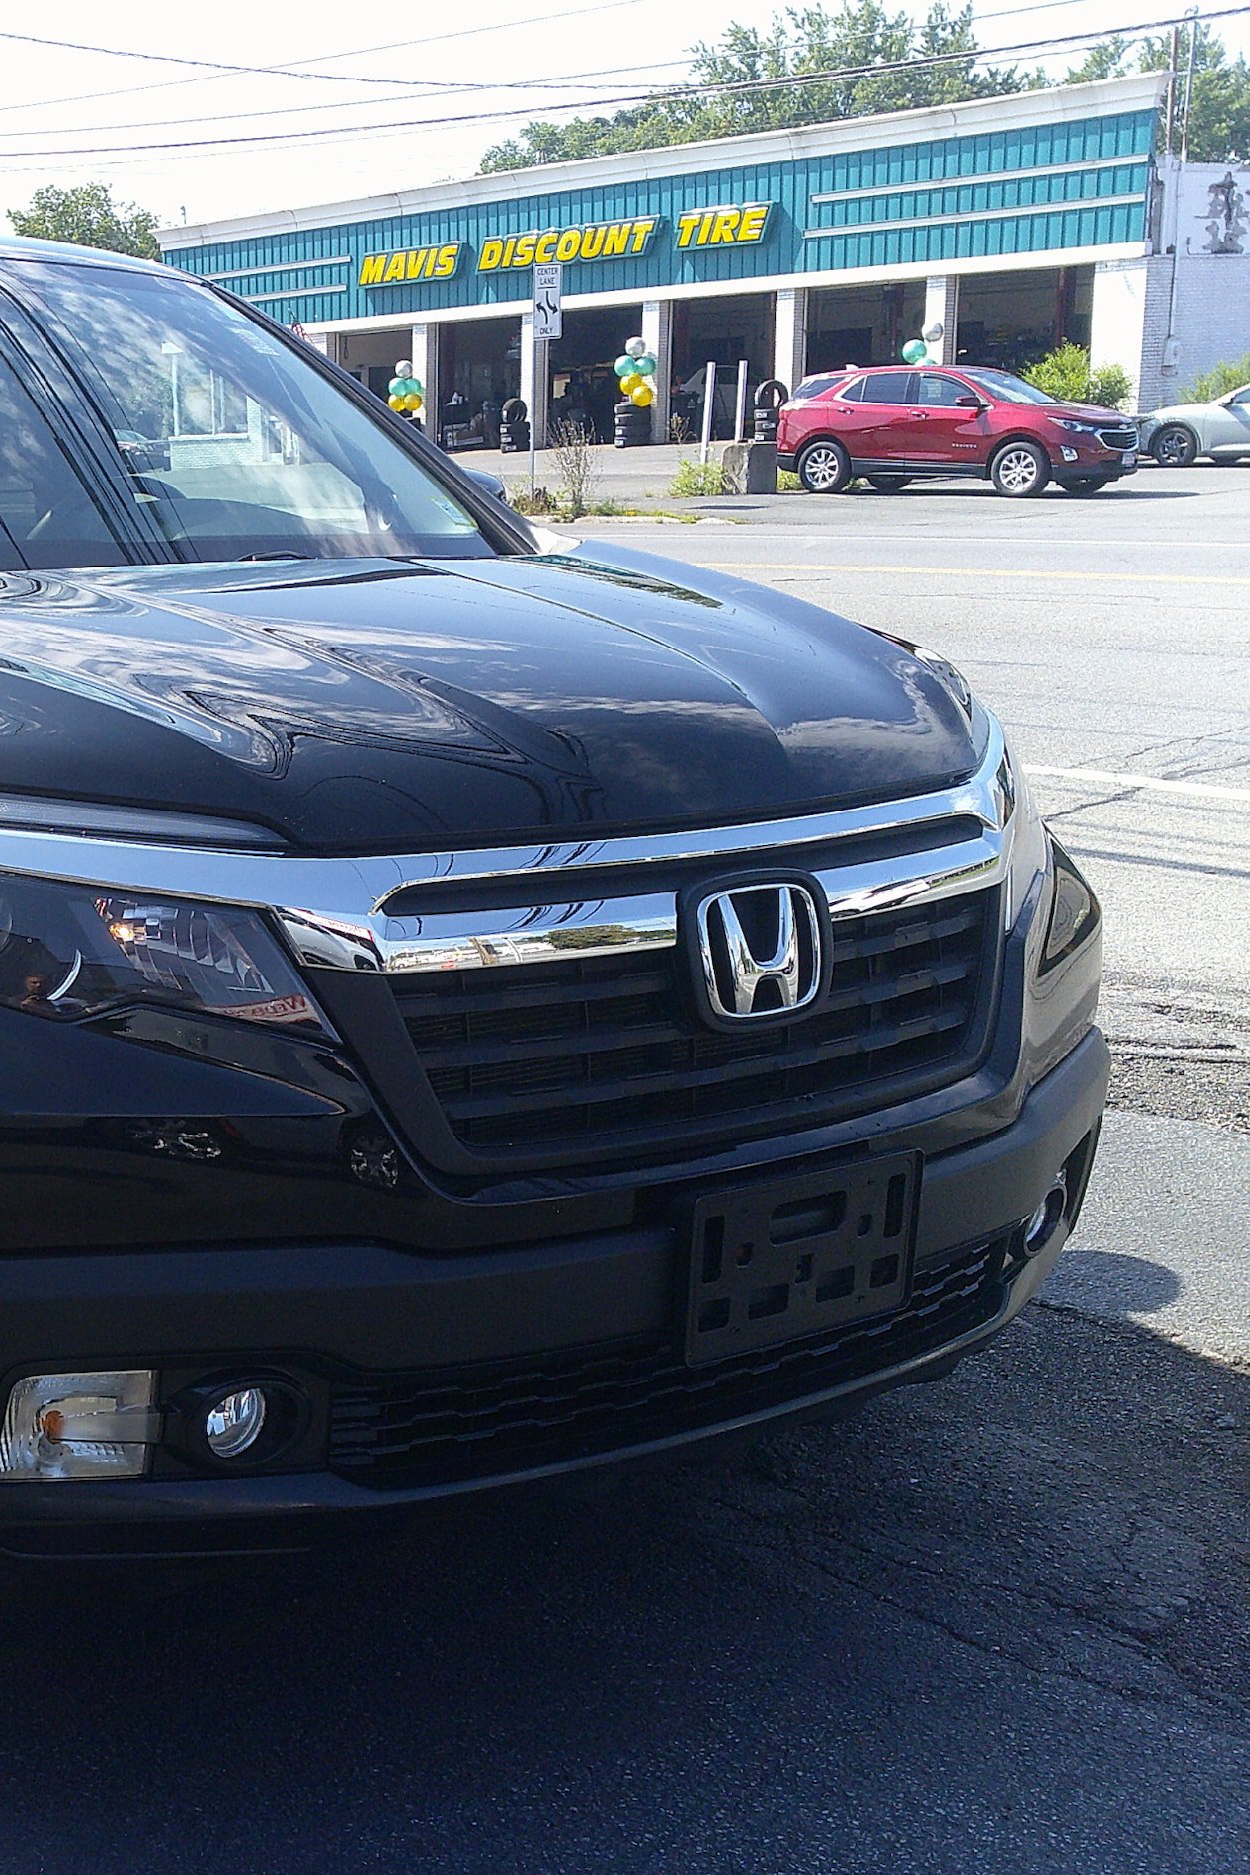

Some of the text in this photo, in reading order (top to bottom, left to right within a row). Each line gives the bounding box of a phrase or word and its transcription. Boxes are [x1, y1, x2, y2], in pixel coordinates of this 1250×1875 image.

[359, 206, 769, 286] MAVIS DISCOUNT TIRE
[537, 267, 558, 276] CENTER
[540, 277, 555, 285] LANE
[540, 327, 553, 335] ONLY
